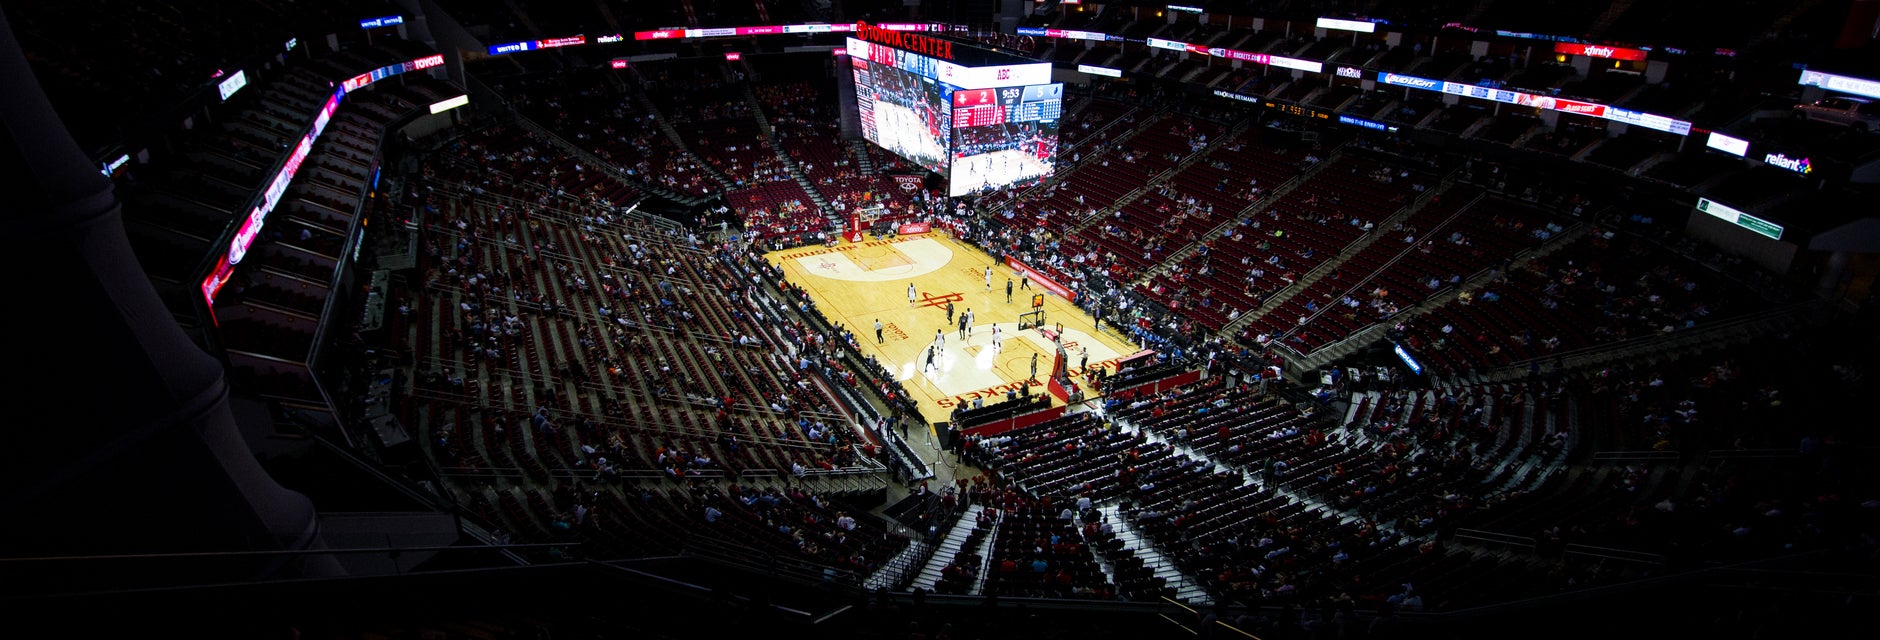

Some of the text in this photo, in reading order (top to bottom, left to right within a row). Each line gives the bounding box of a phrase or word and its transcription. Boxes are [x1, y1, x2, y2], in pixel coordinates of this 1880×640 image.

[597, 35, 618, 43] reliant
[868, 25, 953, 60] TOYOTA CENTER
[1583, 45, 1614, 58] xfinity
[413, 55, 444, 70] TOYOTA
[1408, 78, 1436, 88] LIGHT
[979, 91, 987, 103] 2
[1002, 89, 1020, 99] 9:53
[1037, 87, 1043, 97] 5
[1234, 94, 1258, 103] HERMANN
[1764, 153, 1801, 172] reliant
[895, 176, 922, 184] TOYOTA
